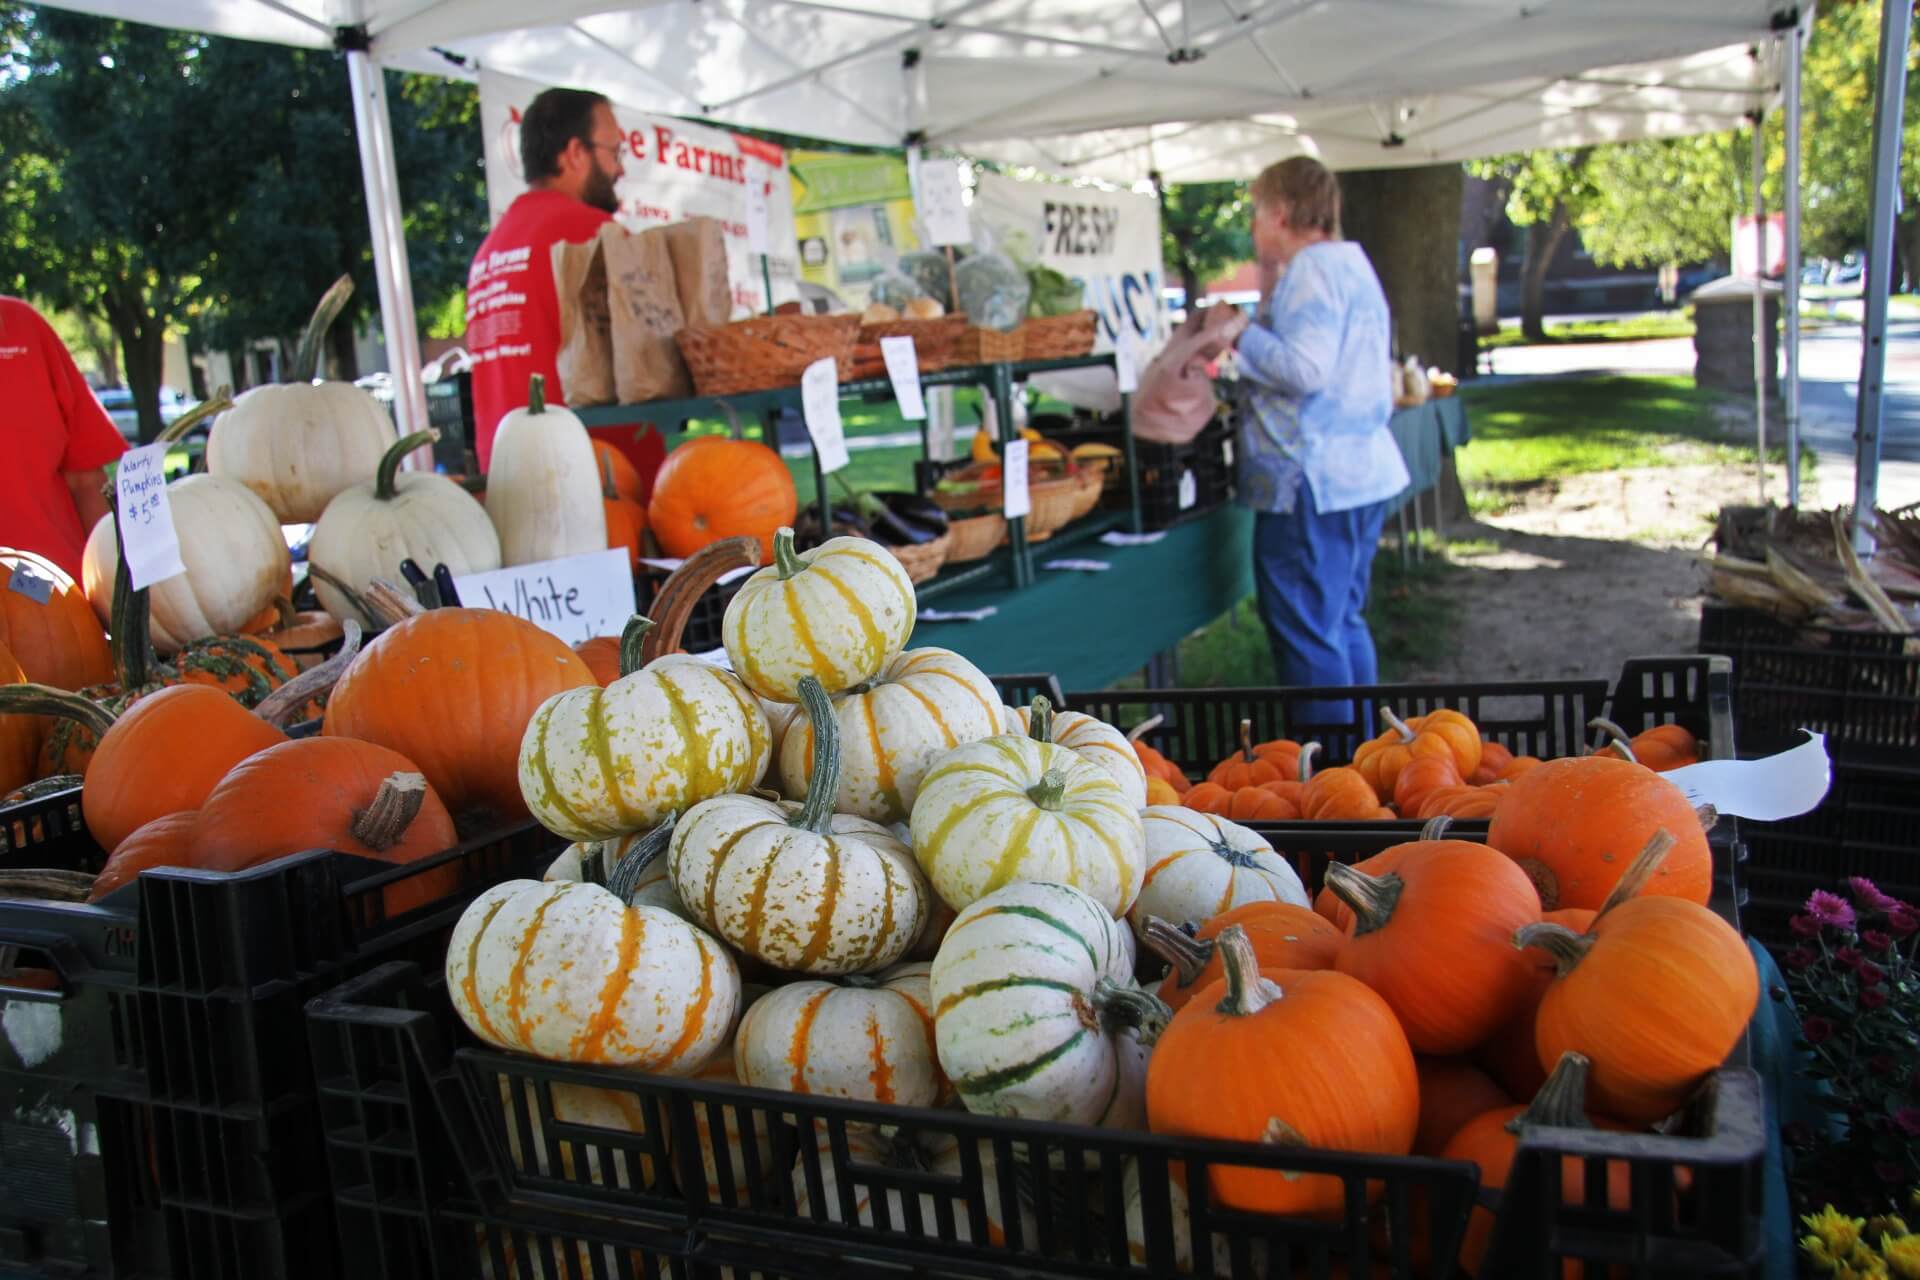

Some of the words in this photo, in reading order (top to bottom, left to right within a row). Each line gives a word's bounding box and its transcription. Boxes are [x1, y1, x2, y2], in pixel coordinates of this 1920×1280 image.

[653, 124, 746, 186] Farms
[1039, 202, 1119, 256] FRESH
[122, 474, 162, 497] Pumpkins
[483, 575, 585, 624] White
